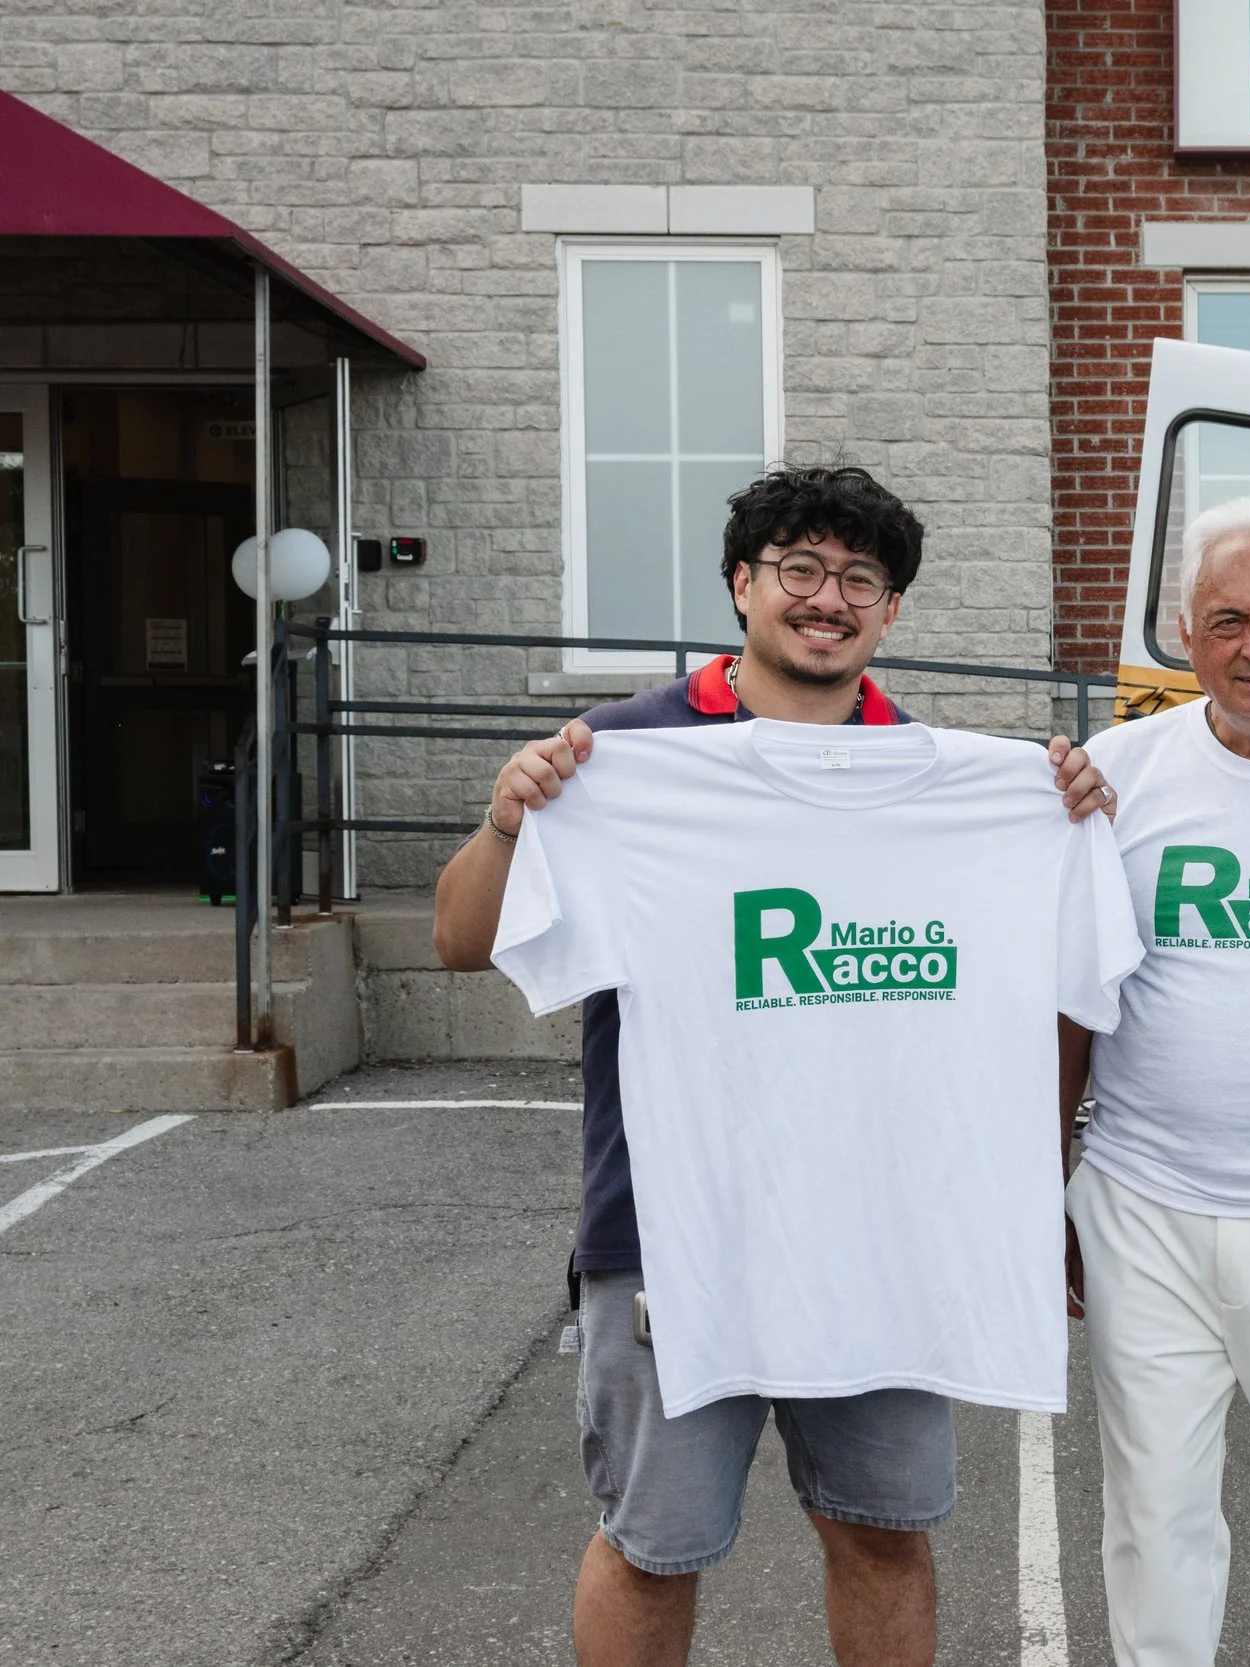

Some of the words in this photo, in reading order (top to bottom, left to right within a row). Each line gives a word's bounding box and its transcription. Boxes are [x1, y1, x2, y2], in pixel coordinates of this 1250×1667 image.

[226, 425, 256, 436] ELEV
[831, 920, 915, 947] Mario
[925, 920, 954, 945] G.
[1155, 938, 1211, 948] RELIABLE.
[735, 996, 796, 1011] RELIABLE.
[799, 991, 879, 1006] RESPONSIBLE.
[882, 991, 956, 1002] RESPONSIVE.
